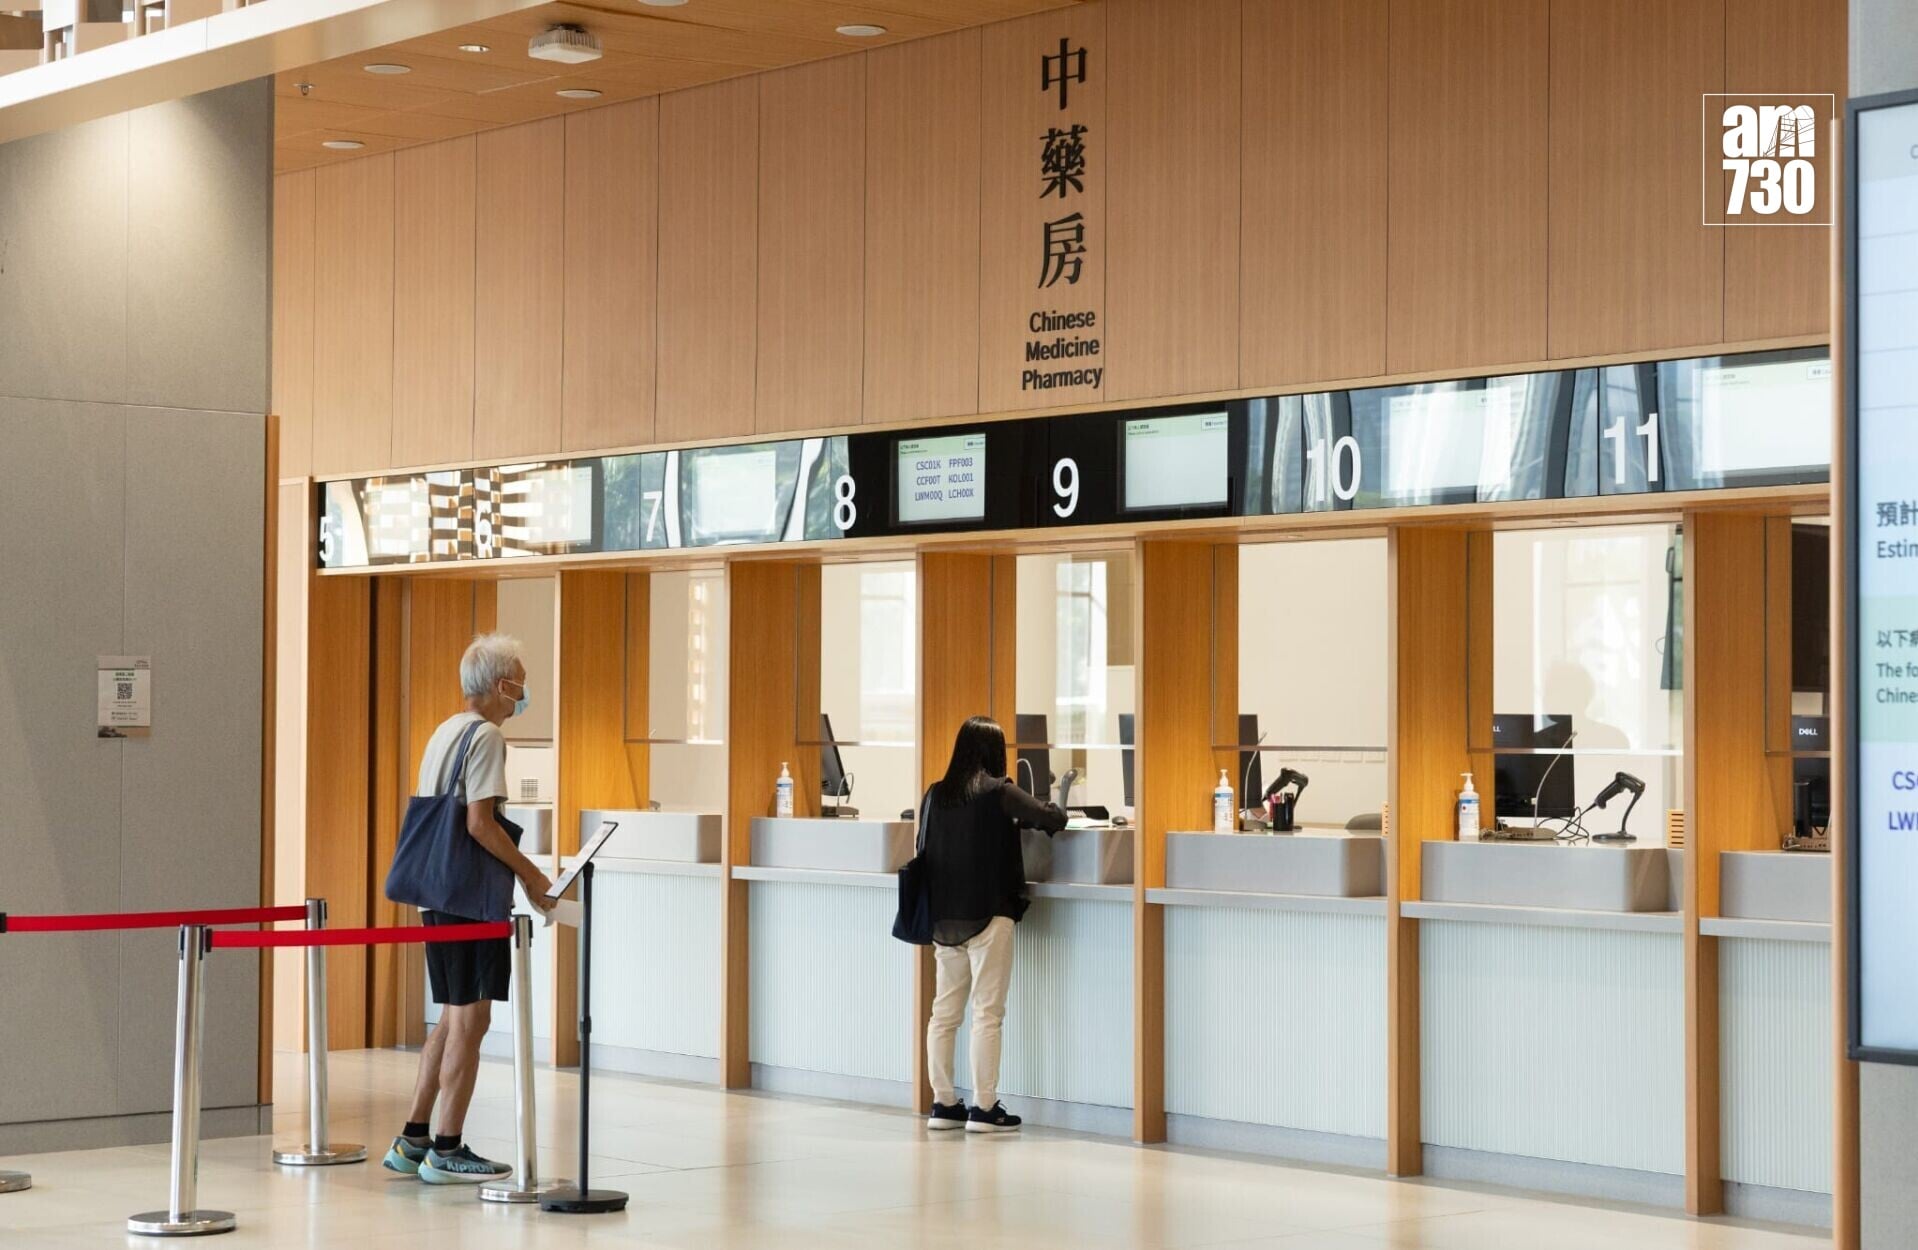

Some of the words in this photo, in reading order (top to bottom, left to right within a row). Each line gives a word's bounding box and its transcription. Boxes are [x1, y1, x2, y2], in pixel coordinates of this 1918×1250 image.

[1038, 37, 1088, 289] 中藥房
[1029, 310, 1096, 333] Chinese
[1025, 336, 1100, 362] Medicine
[1022, 367, 1103, 391] Pharmacy
[1306, 436, 1362, 502] 10
[1603, 412, 1659, 485] 11
[833, 474, 857, 530] 8
[1053, 457, 1079, 518] 9
[319, 516, 334, 562] 5
[475, 503, 493, 557] 6
[643, 490, 663, 542] 7
[1876, 662, 1903, 678] The
[1799, 727, 1818, 736] DELL
[1892, 771, 1918, 791] CS
[1888, 811, 1918, 831] LW
